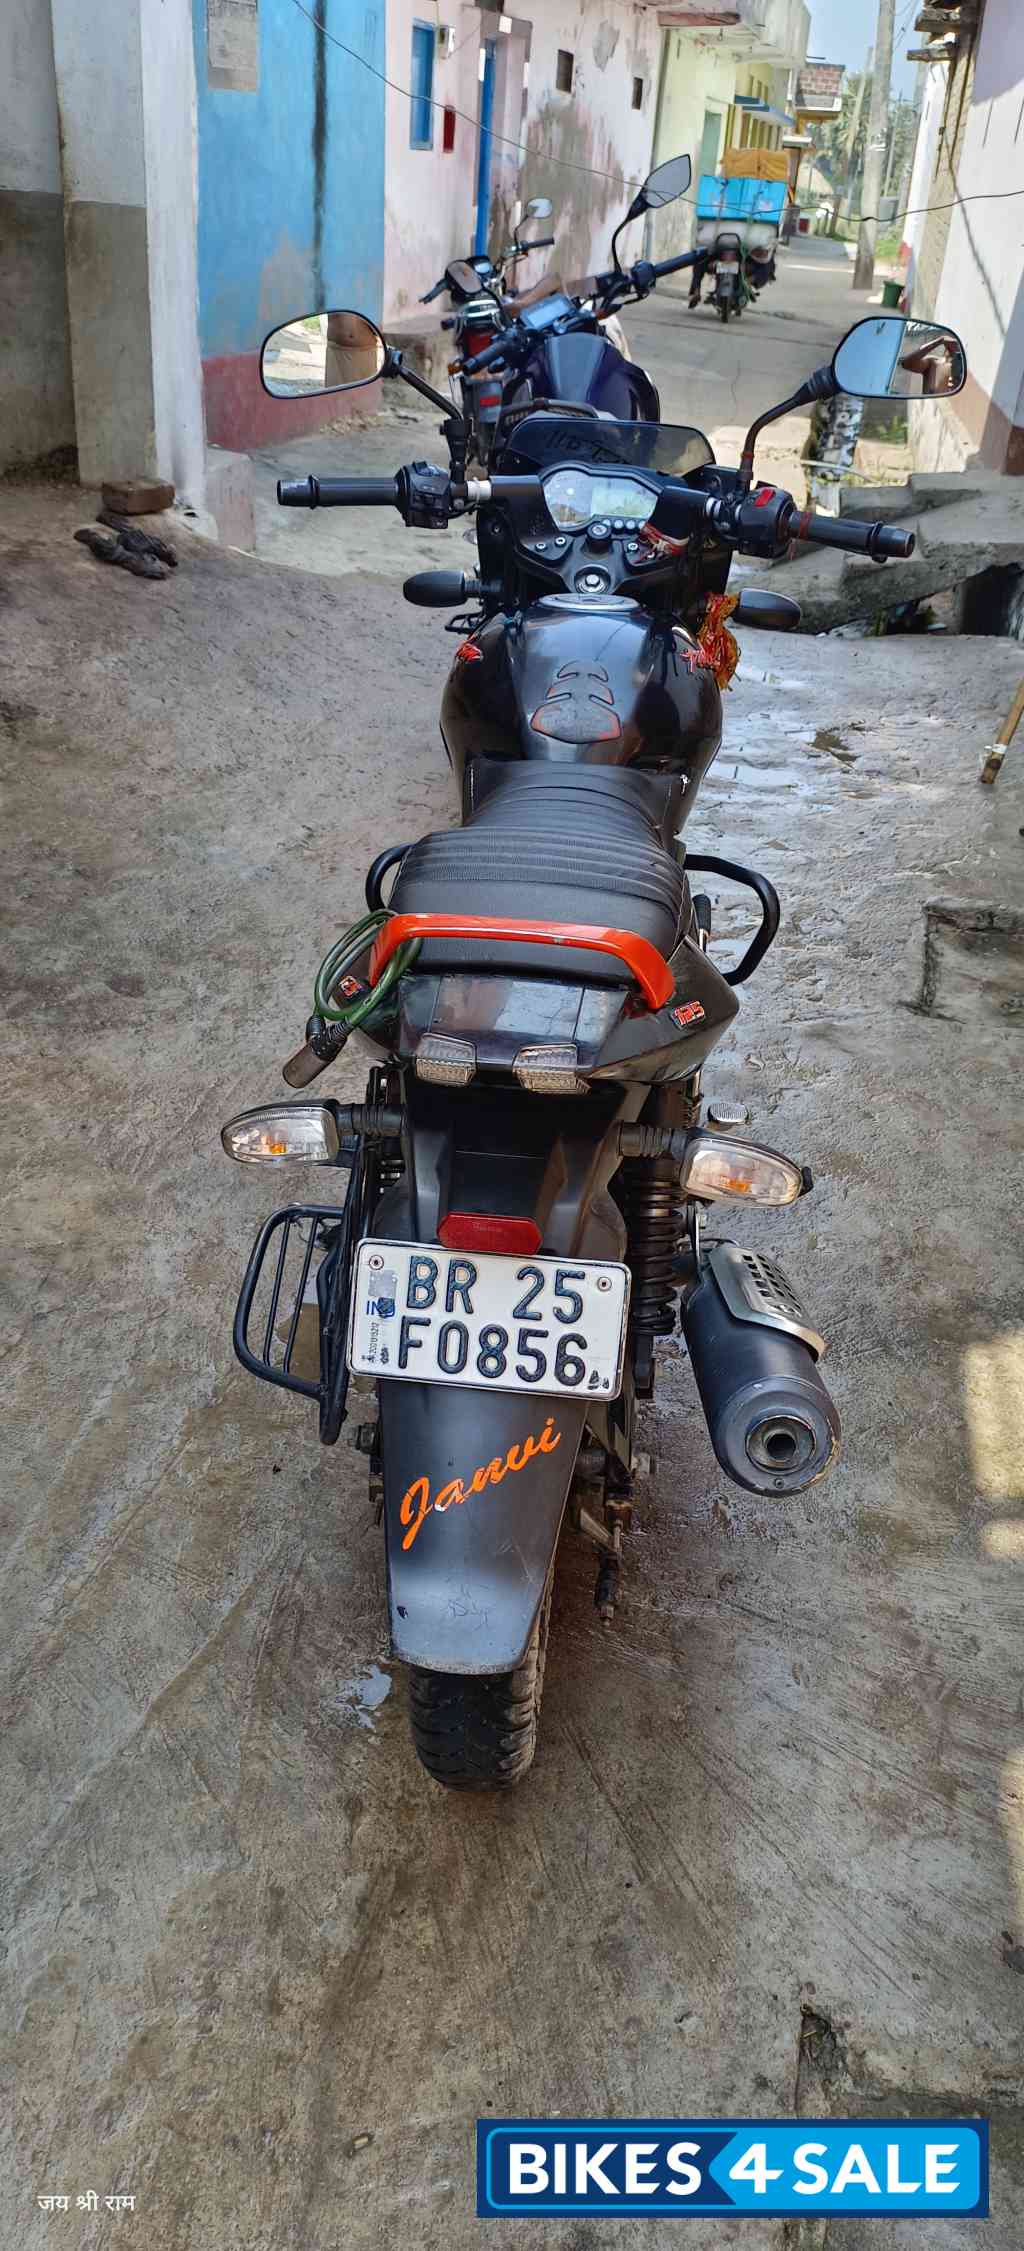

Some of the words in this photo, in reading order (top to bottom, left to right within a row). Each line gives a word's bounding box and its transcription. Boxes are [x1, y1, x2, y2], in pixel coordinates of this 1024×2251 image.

[407, 1255, 478, 1315] BR
[512, 1266, 586, 1325] 25
[397, 1315, 588, 1387] F0856
[400, 1416, 561, 1550] Janvi
